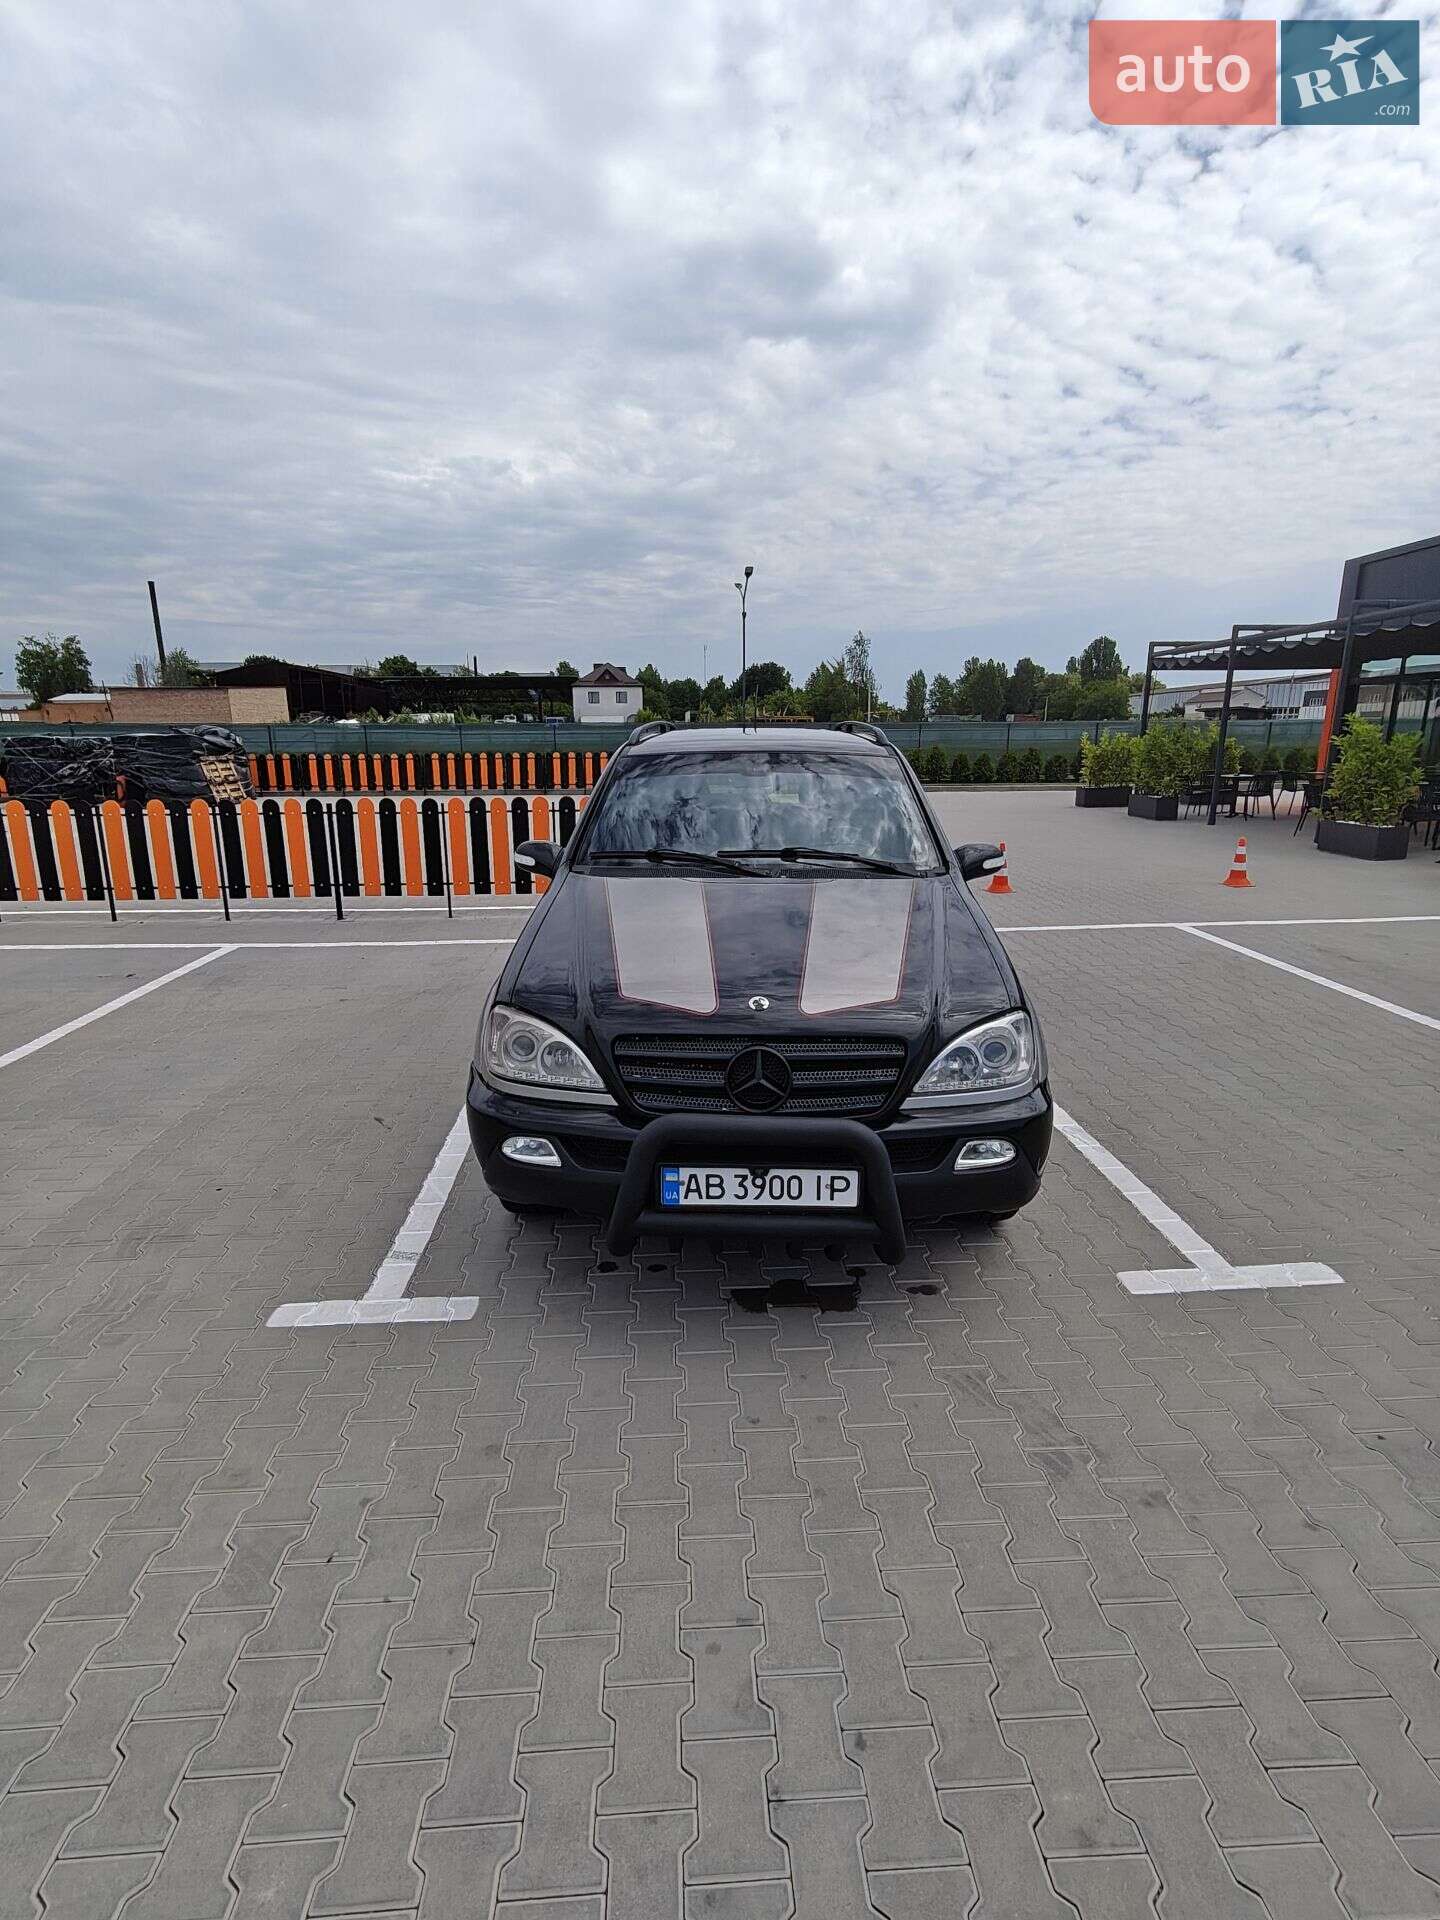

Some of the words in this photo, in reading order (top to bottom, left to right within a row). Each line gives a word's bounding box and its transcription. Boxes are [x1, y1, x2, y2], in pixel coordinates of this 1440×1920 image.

[664, 1192, 679, 1200] UA
[683, 1173, 726, 1200] AB
[733, 1174, 803, 1201] 3900
[816, 1175, 851, 1201] IP
